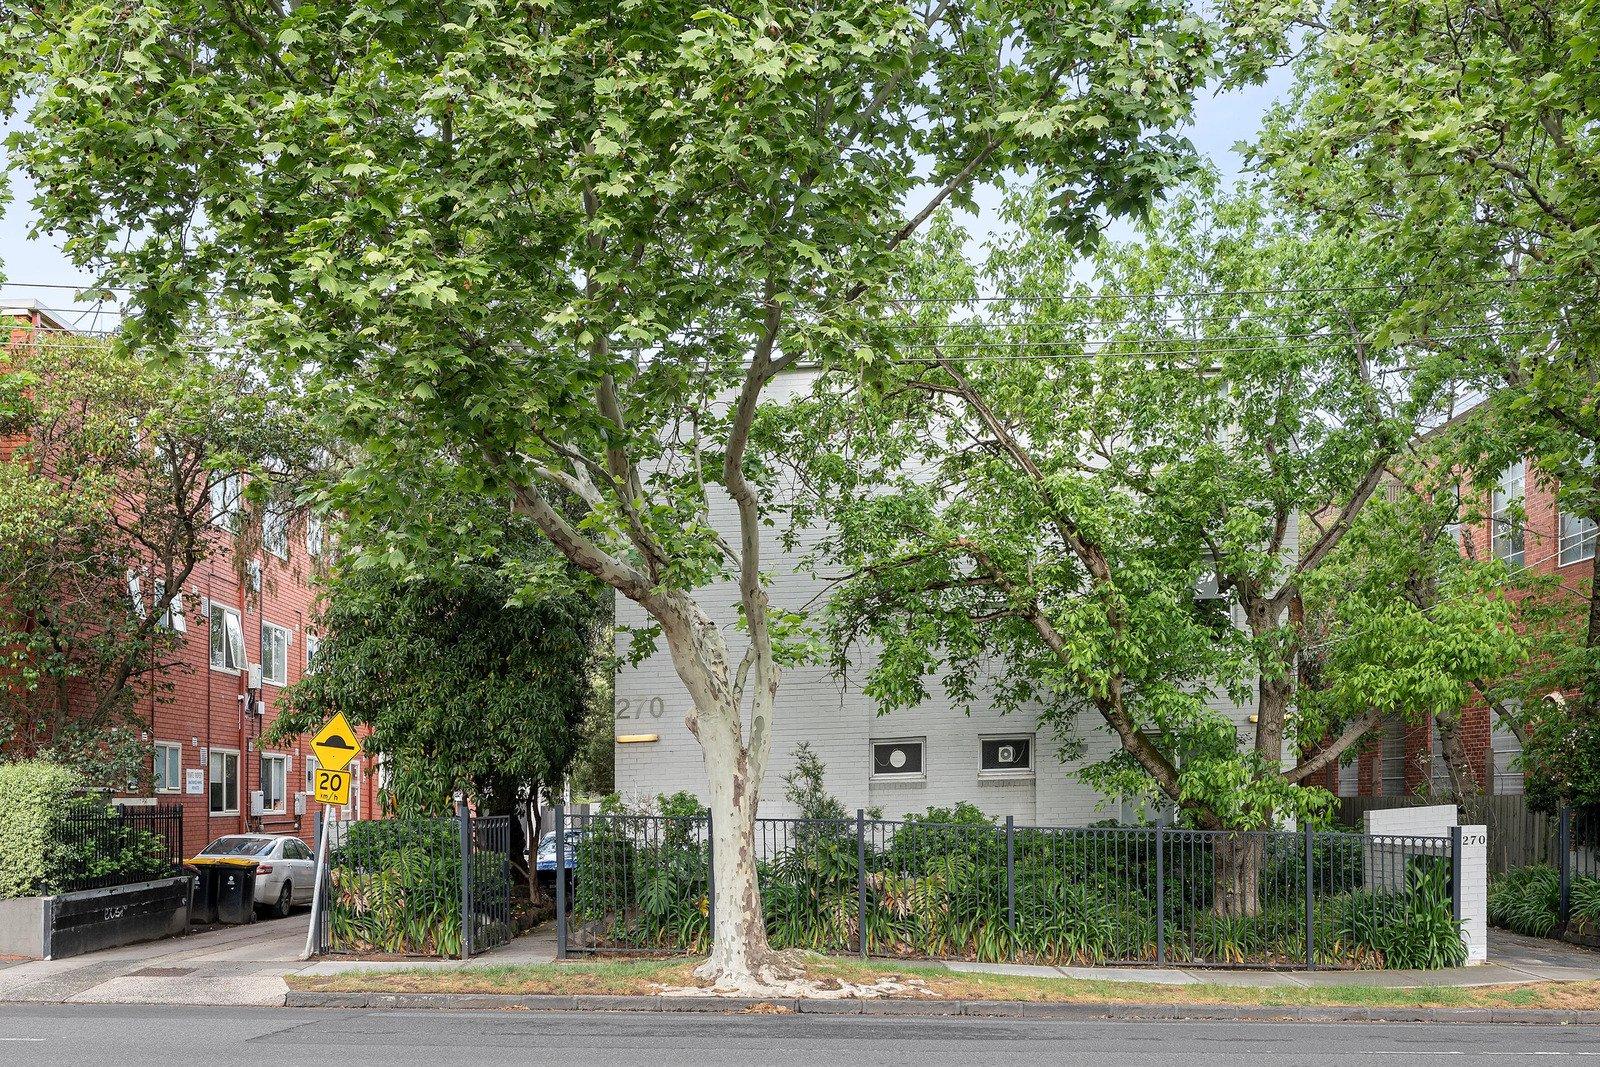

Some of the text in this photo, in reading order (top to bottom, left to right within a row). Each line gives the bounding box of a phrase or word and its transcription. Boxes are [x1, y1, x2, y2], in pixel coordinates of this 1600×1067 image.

[616, 696, 665, 719] 270
[319, 772, 342, 791] 20
[1462, 834, 1486, 846] 270
